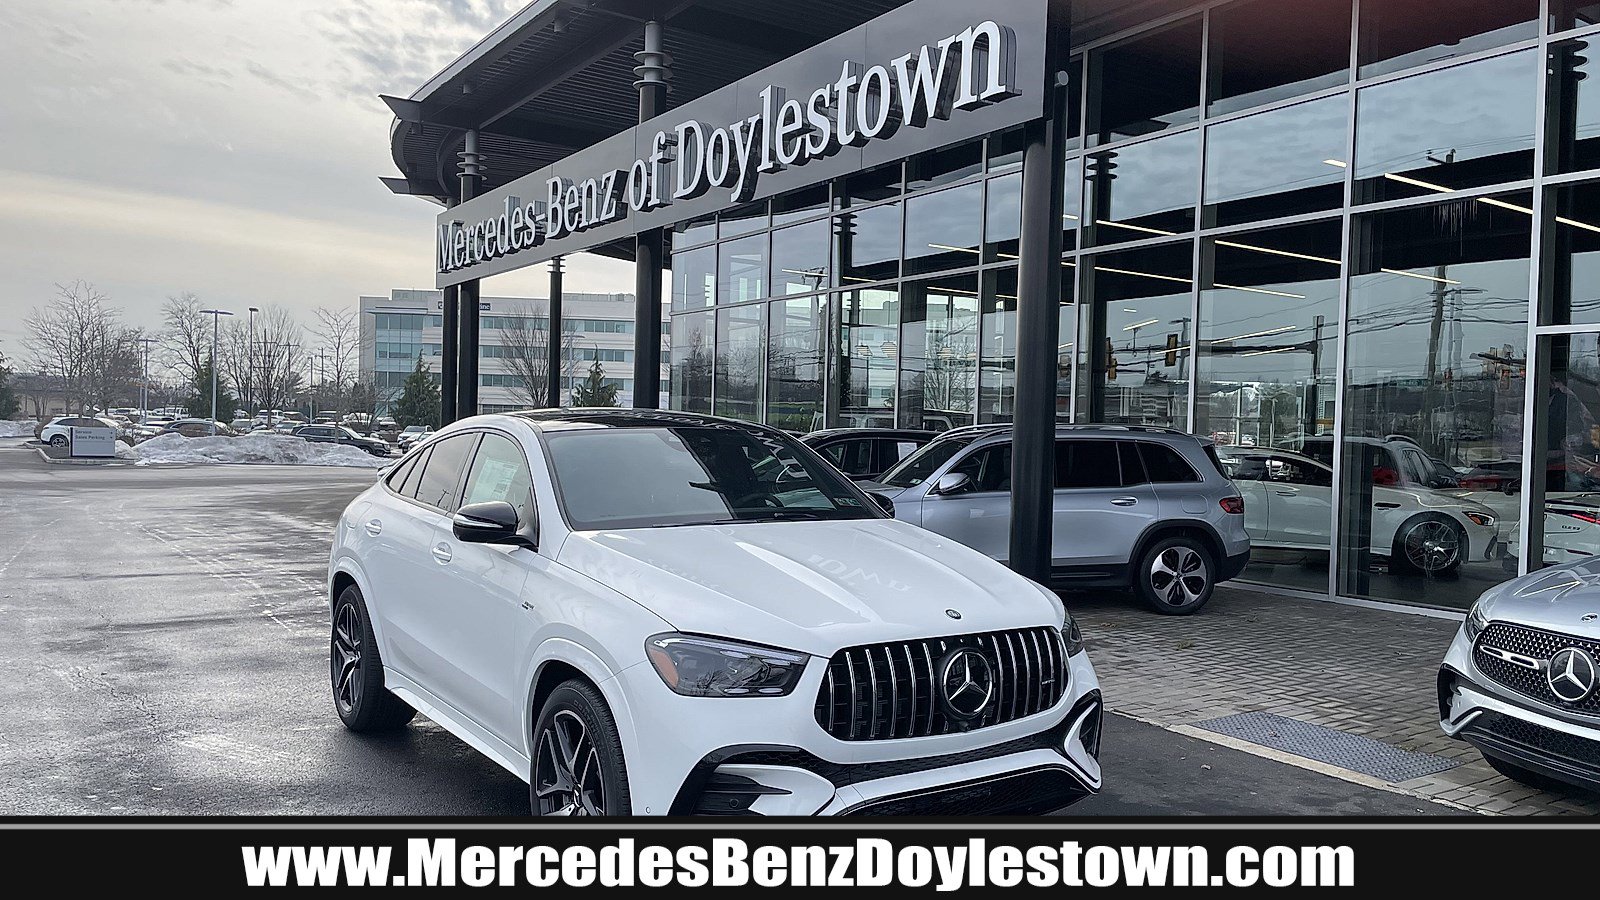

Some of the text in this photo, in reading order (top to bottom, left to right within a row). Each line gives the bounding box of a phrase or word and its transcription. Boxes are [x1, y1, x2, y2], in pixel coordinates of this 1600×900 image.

[437, 20, 1018, 273] Mercedes-Benz of Doylestown
